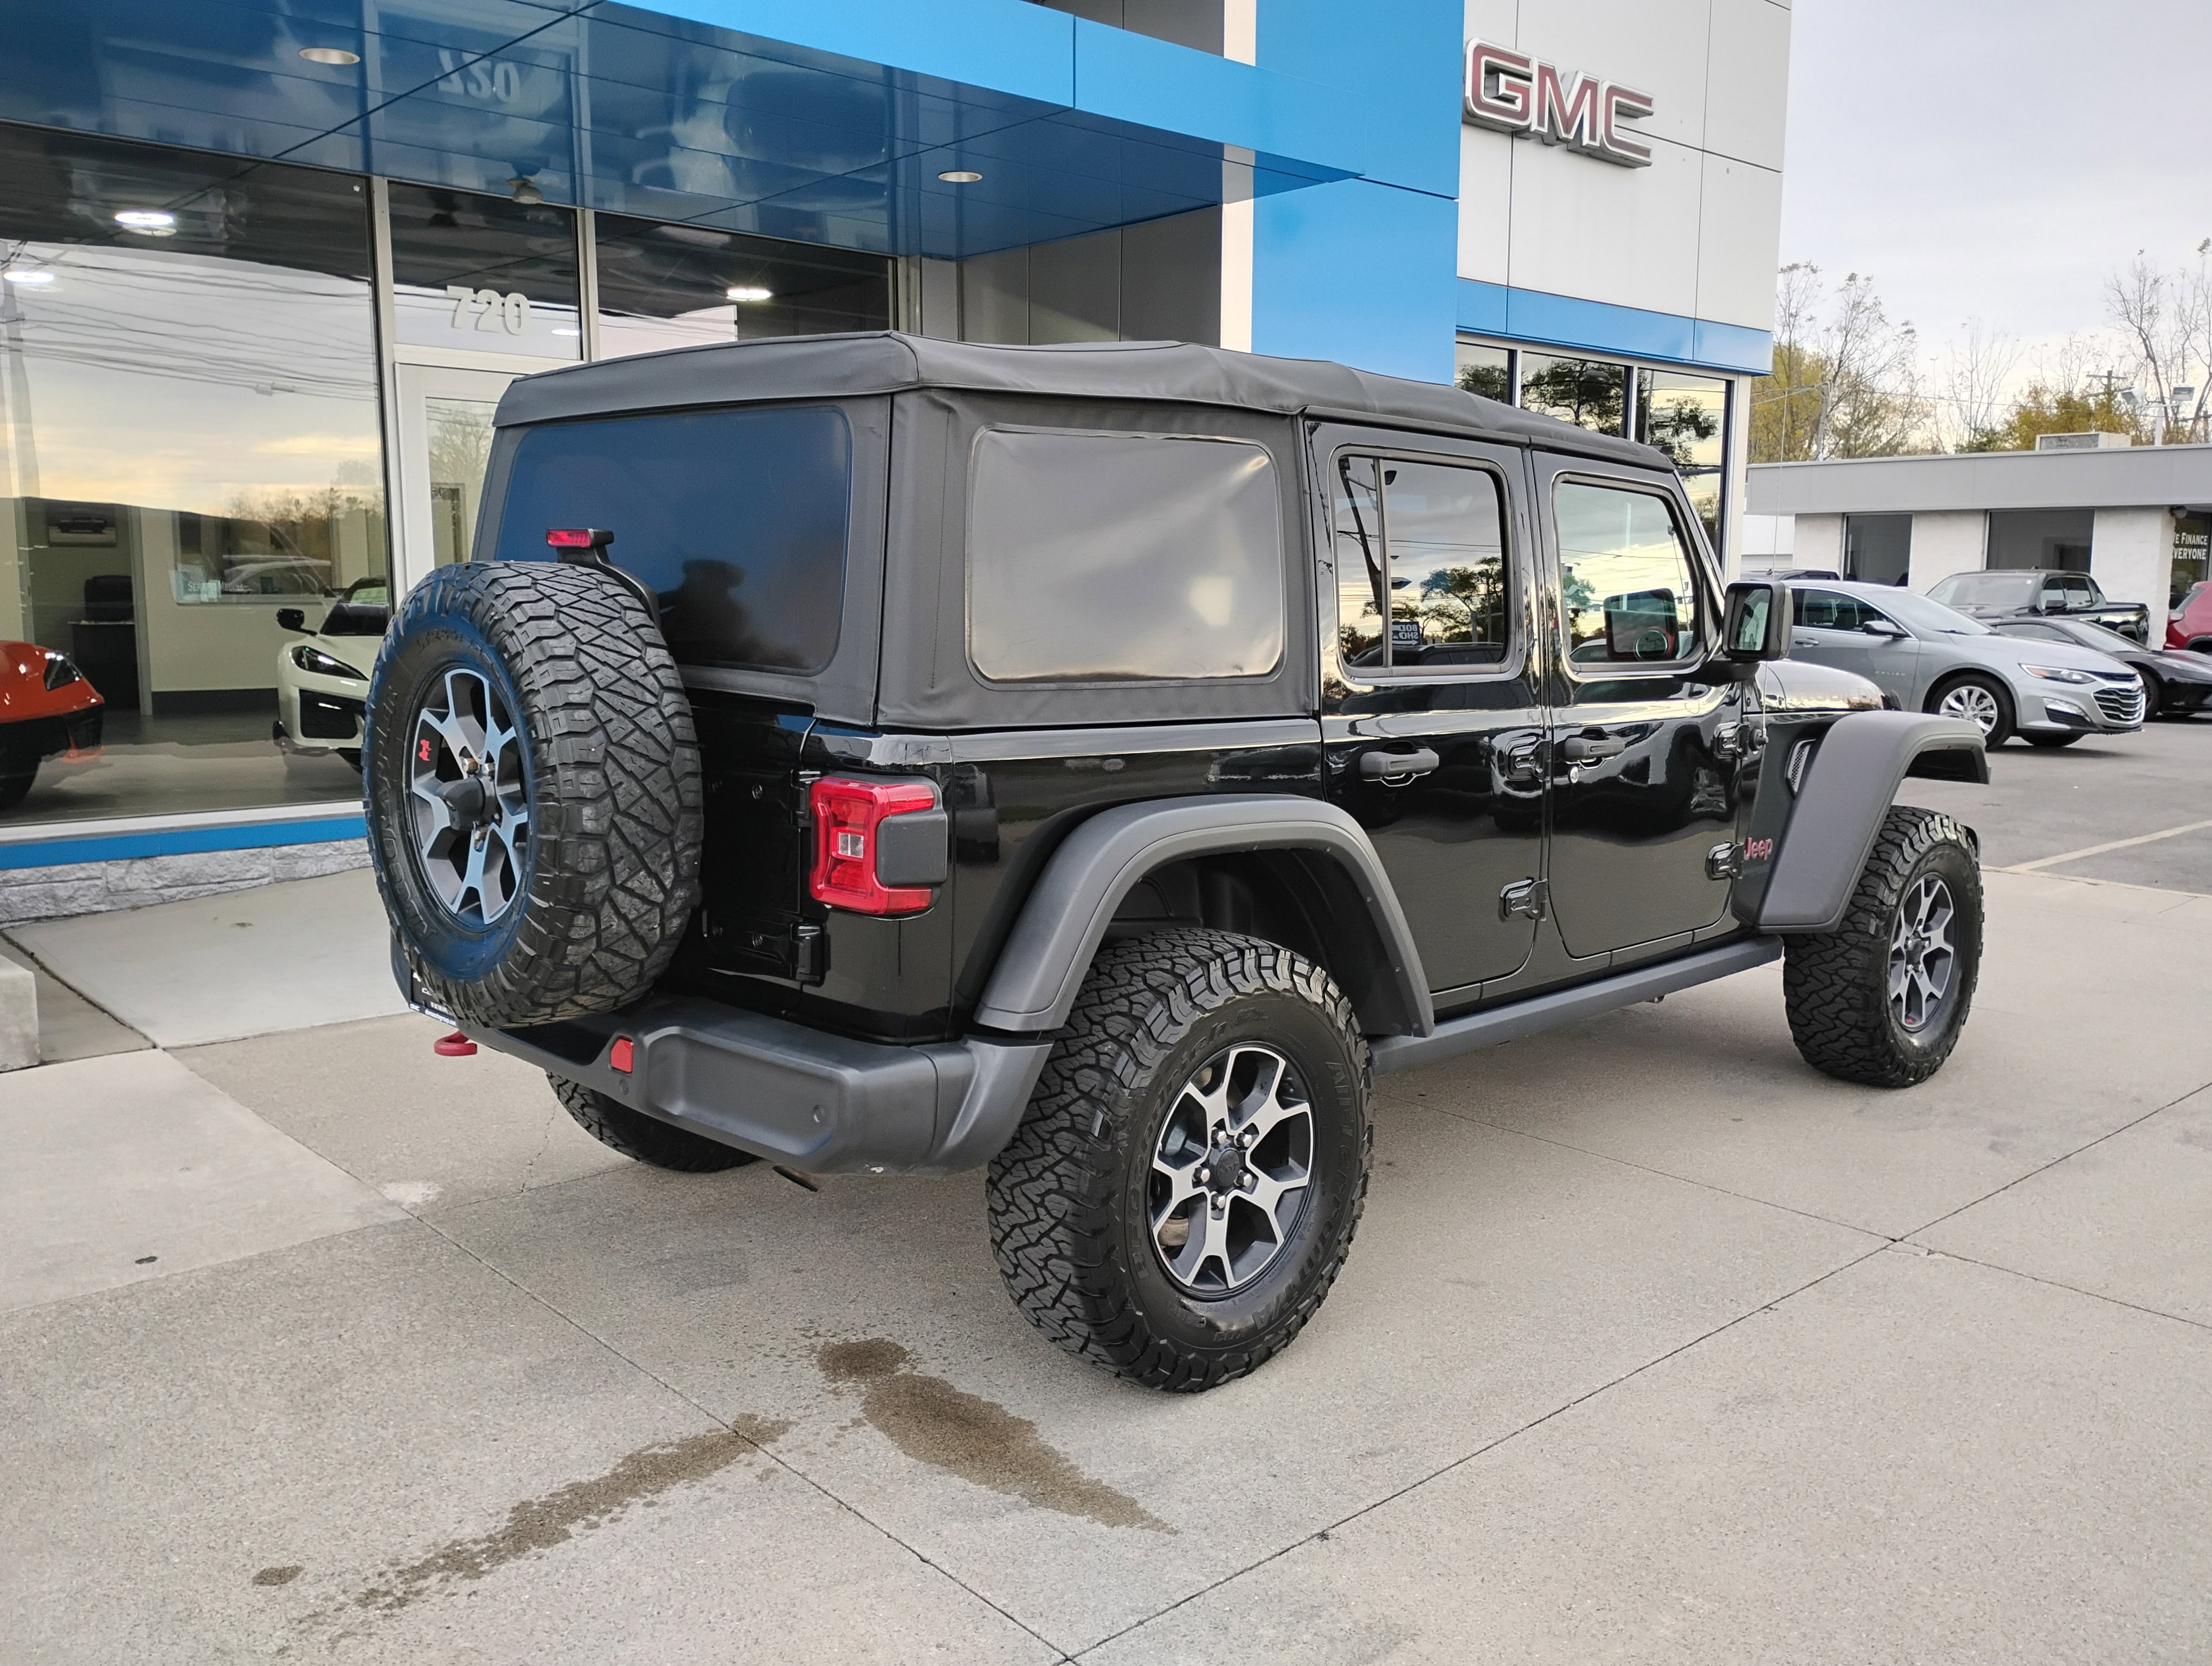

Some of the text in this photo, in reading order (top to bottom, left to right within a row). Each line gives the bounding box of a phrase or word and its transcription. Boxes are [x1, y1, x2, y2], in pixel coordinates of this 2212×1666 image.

[1465, 37, 1654, 167] GMC
[447, 285, 530, 336] 720
[2174, 548, 2207, 560] VERYONE
[1744, 837, 1773, 861] Jeep
